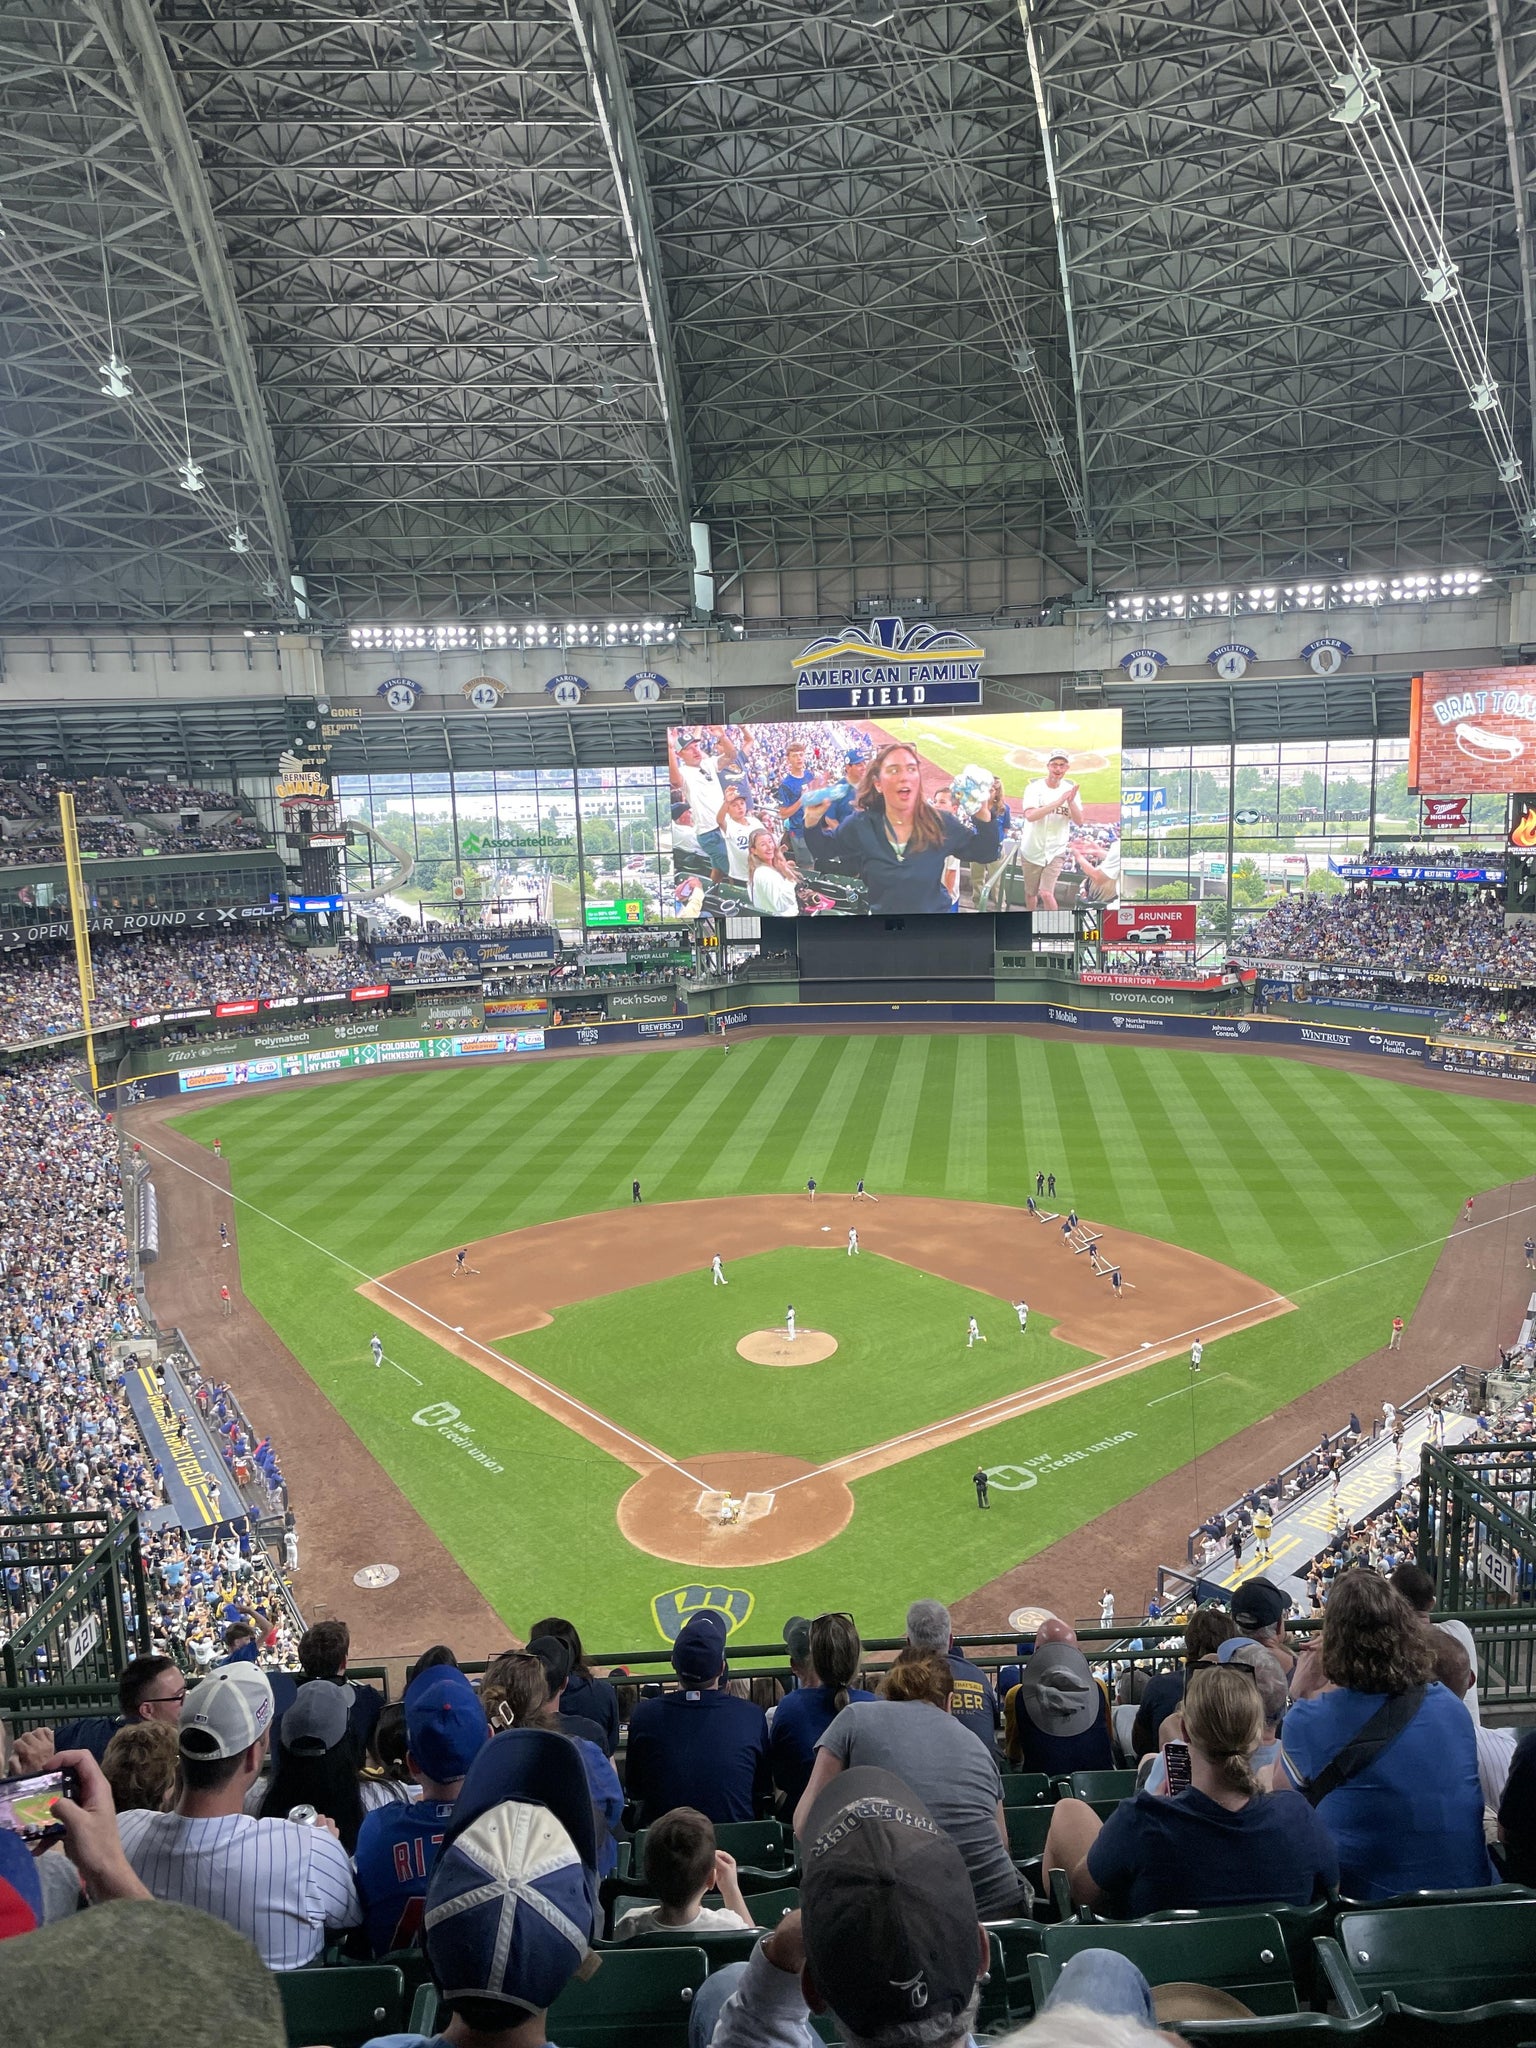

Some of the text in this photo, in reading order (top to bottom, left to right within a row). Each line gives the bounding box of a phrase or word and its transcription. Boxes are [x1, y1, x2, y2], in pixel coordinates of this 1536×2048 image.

[1214, 646, 1250, 656] MOLITOR
[1310, 640, 1342, 654] UECKER
[1132, 663, 1154, 678] 19
[1225, 658, 1236, 673] 4
[555, 675, 579, 684] AARON
[635, 672, 657, 680] SELIG
[798, 663, 980, 687] AMERICAN FAMILY
[384, 679, 416, 689] FINGERS
[391, 691, 411, 705] 34
[474, 689, 495, 704] 42
[557, 688, 577, 702] 44
[643, 685, 650, 699] 1
[851, 686, 926, 706] FIELD
[330, 708, 362, 717] GONE!
[283, 773, 320, 782] BERNIE'S
[275, 781, 330, 798] CHALET
[481, 835, 573, 849] Associated Bank
[241, 905, 284, 917] GOLF
[1138, 912, 1182, 921] 4RUNNER
[28, 923, 69, 941] OPEN
[123, 912, 187, 929] ROUND
[512, 951, 548, 959] MILWAUKEE
[1083, 975, 1156, 985] TOYOTA TERRITORY
[1427, 974, 1447, 983] 620
[1449, 976, 1481, 985] WTMJ
[1261, 983, 1290, 996] Culver's
[644, 994, 668, 1003] Save
[1109, 993, 1174, 1004] TOYOTA.COM
[428, 1006, 472, 1019] Johnsonville
[724, 1013, 748, 1024] Mobile
[1055, 1010, 1077, 1023] Mobile
[346, 1024, 379, 1035] clover
[576, 1029, 599, 1040] TRUSS
[255, 1033, 309, 1047] Polymatech
[1301, 1028, 1351, 1044] WINTRUST
[382, 1041, 419, 1051] COLORADO
[1383, 1038, 1405, 1047] Aurora
[168, 1050, 196, 1062] Tito's
[308, 1049, 349, 1060] PHILADELPHIA
[353, 1047, 359, 1055] 5
[382, 1051, 424, 1061] MINNESOTA
[1382, 1045, 1422, 1056] Health Care
[321, 1060, 341, 1068] METS
[1502, 1073, 1529, 1081] BULLPEN
[453, 1421, 475, 1433] uw
[438, 1426, 504, 1474] credit union
[1039, 1429, 1138, 1474] credit union
[1024, 1452, 1052, 1467] uw
[176, 1459, 206, 1487] FIELD
[1485, 1554, 1507, 1586] 421
[74, 1623, 93, 1656] 421
